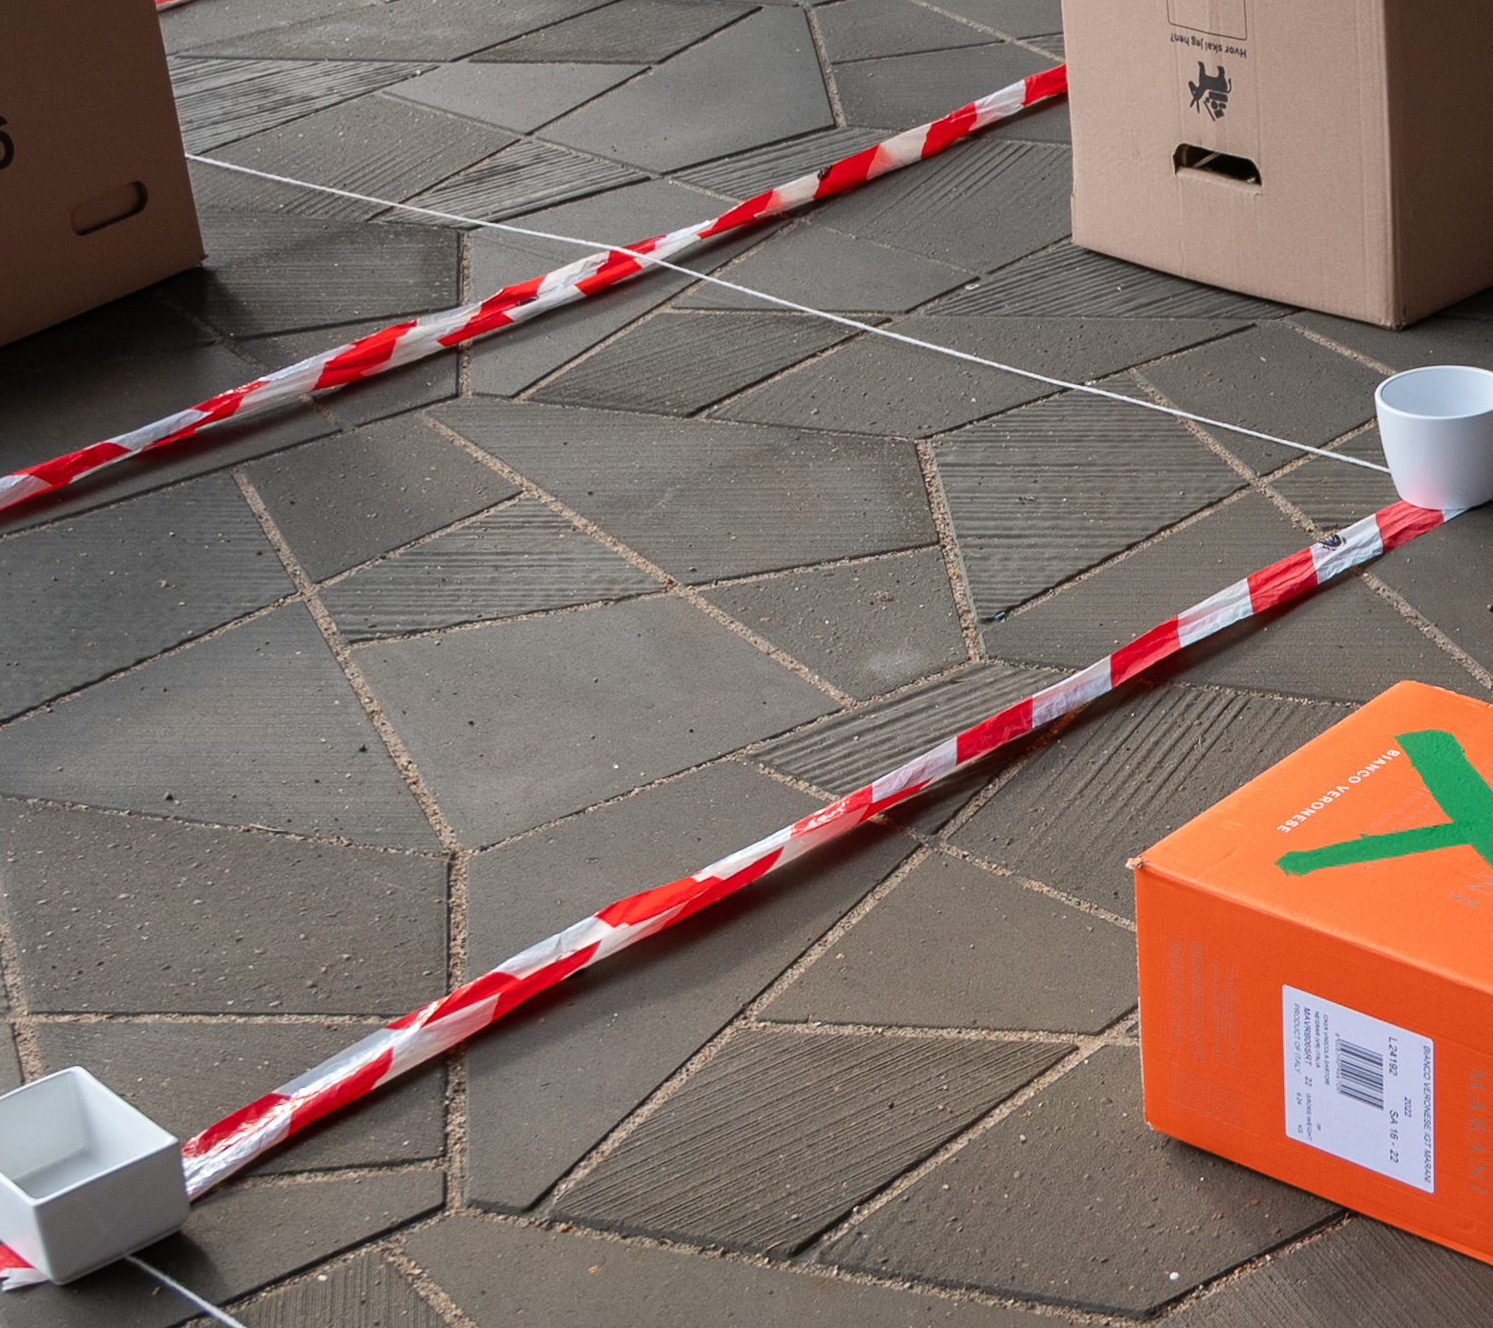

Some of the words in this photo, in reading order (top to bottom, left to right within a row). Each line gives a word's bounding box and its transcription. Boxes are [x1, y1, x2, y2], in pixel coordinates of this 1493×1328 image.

[1170, 32, 1190, 48] hen?
[1190, 35, 1204, 50] jeg
[1204, 40, 1223, 54] skal
[1224, 45, 1247, 59] Hvor
[1346, 748, 1402, 786] BIANCO
[1275, 784, 1349, 834] VERONESE
[1423, 1045, 1431, 1081] BIANCO
[1404, 1096, 1412, 1118] 2022
[1423, 1081, 1431, 1131] VERONESE
[1389, 1109, 1399, 1126] SA
[1468, 1065, 1488, 1196] MARANI
[1389, 1148, 1399, 1164] 22
[1424, 1148, 1432, 1184] MARANI
